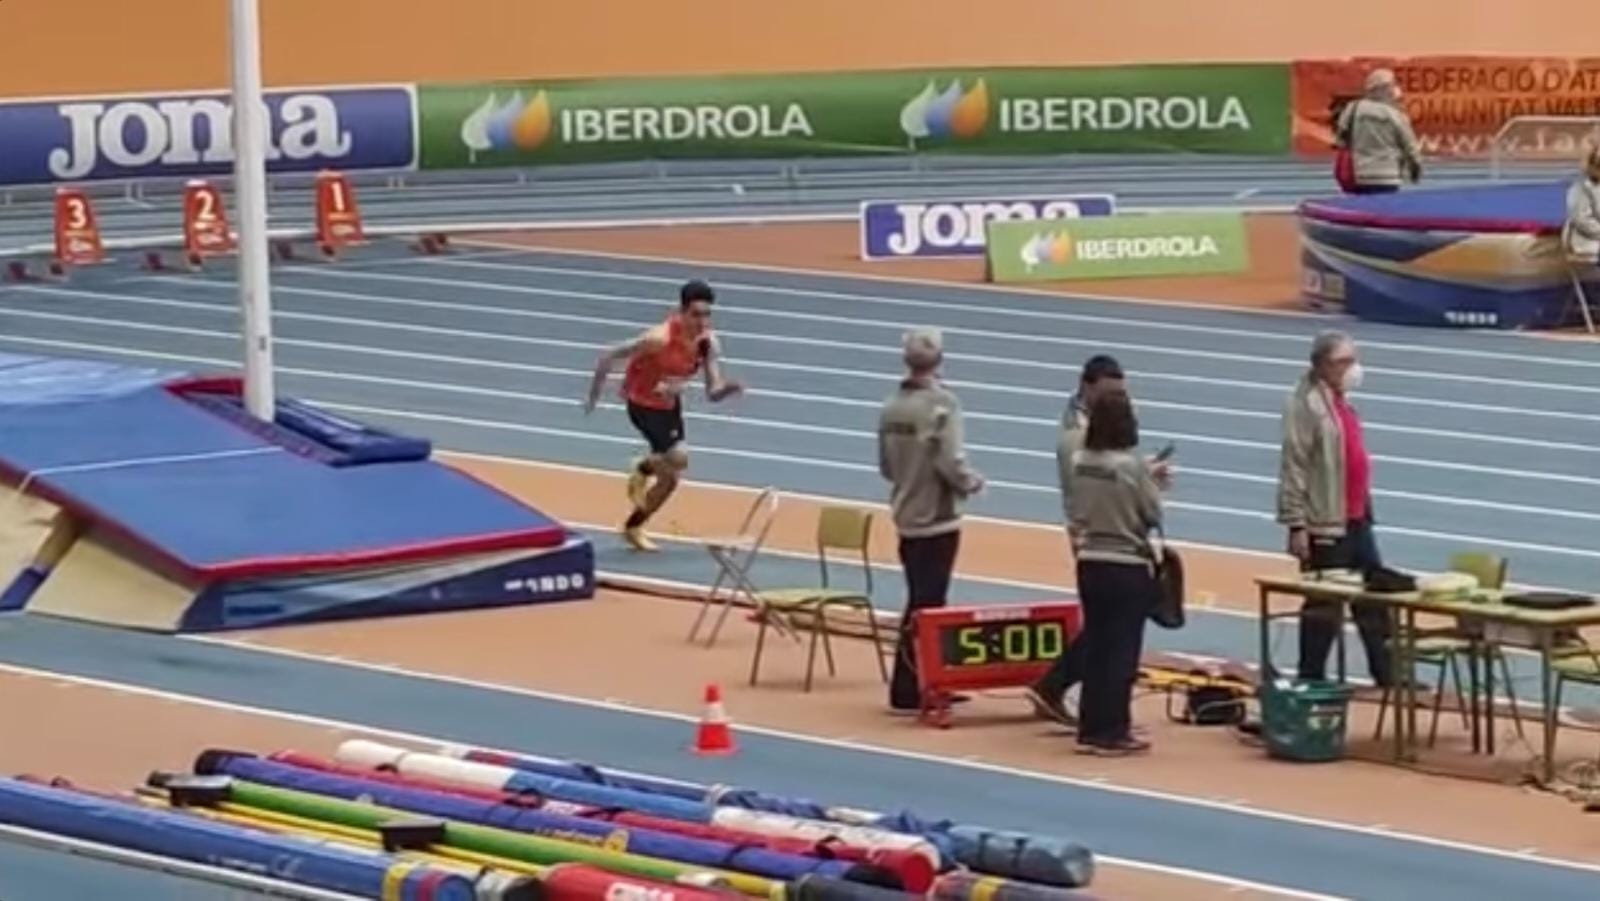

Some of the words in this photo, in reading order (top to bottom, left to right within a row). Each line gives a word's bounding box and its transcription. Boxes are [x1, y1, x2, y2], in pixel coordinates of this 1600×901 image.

[561, 103, 813, 142] IBERDROLA
[1000, 96, 1251, 132] IBERDROLA
[199, 191, 216, 220] 2
[331, 182, 345, 212] 1
[67, 198, 86, 229] 3
[1076, 234, 1219, 261] IBERDROLA
[959, 622, 1063, 664] 5:00
